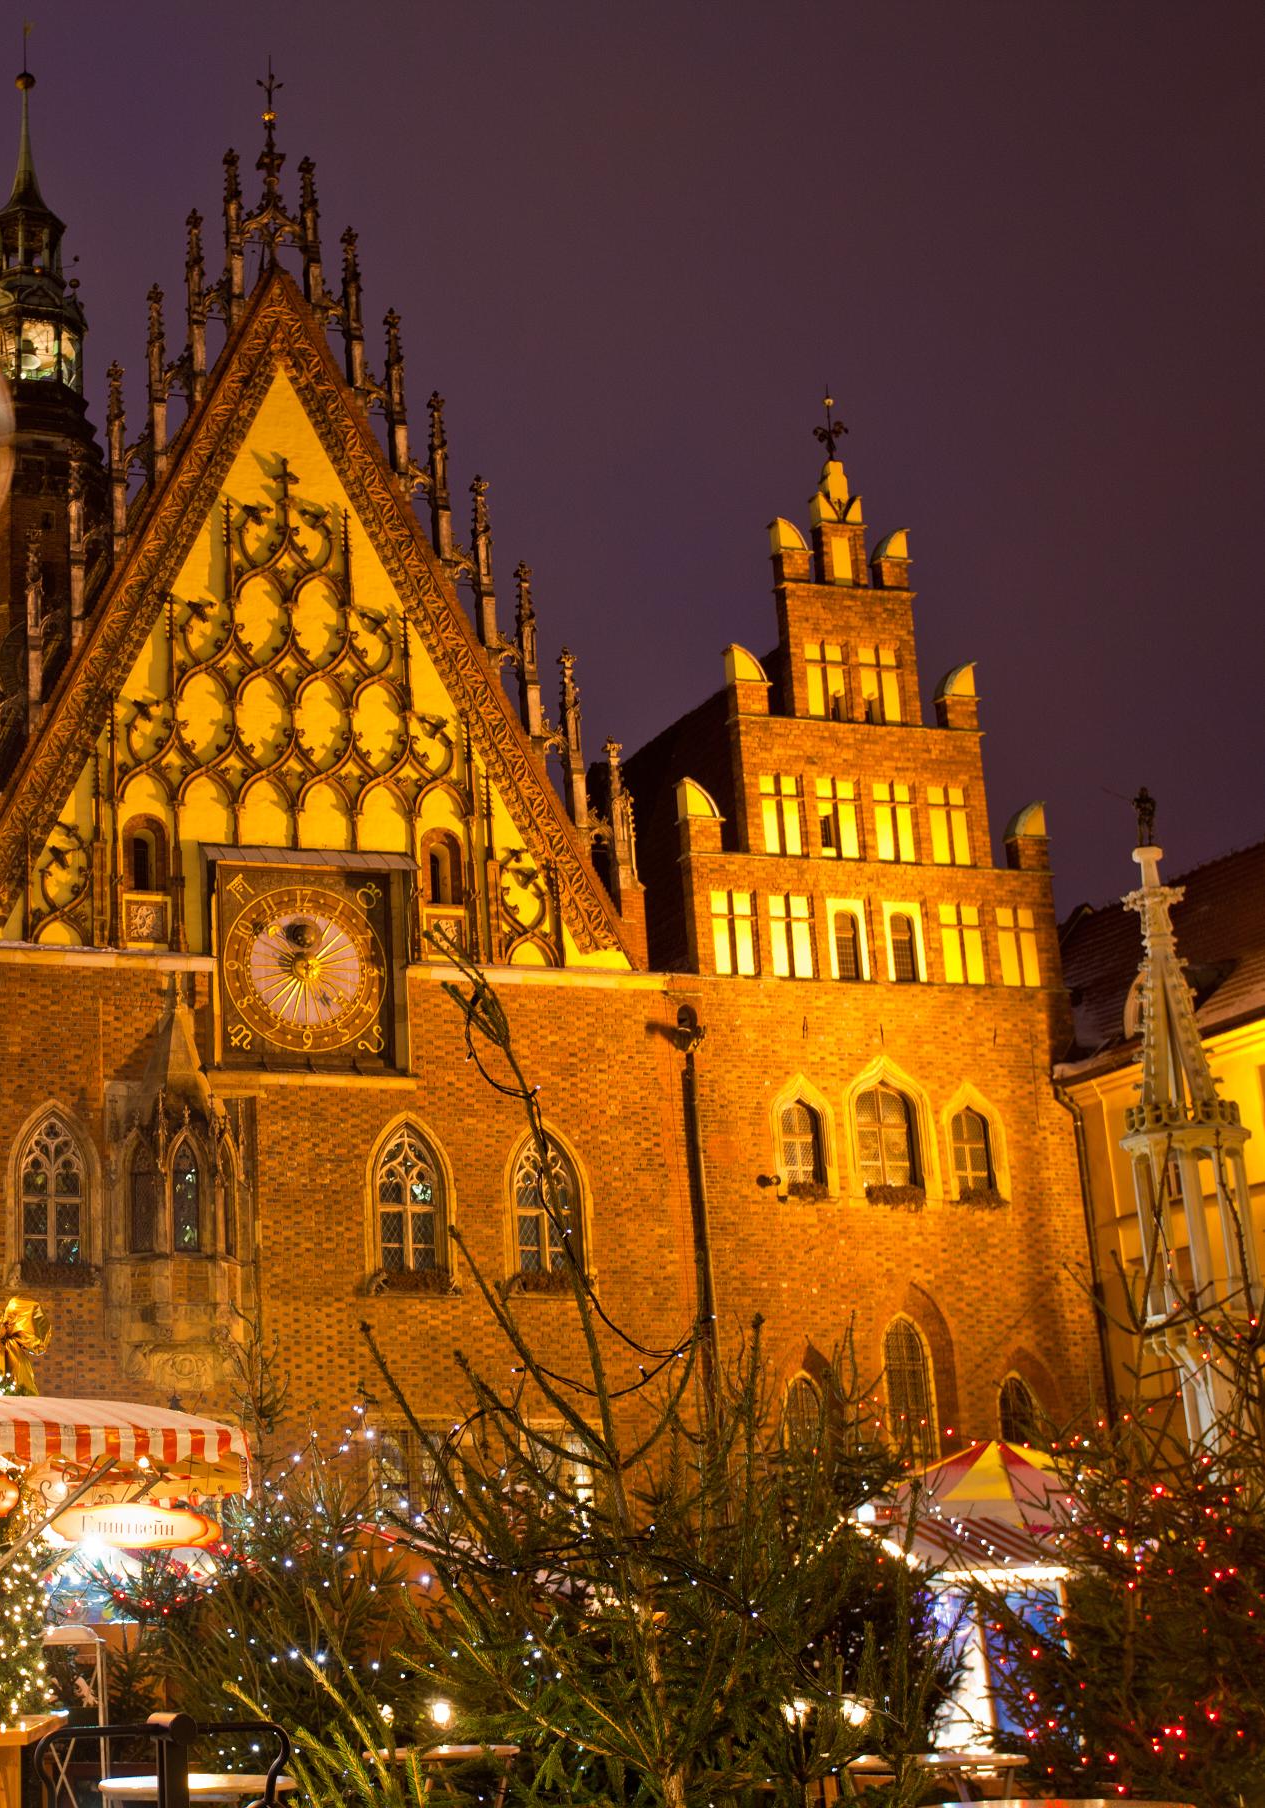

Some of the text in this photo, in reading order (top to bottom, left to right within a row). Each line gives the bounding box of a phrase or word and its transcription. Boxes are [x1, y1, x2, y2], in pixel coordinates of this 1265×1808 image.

[295, 889, 313, 907] 12
[235, 920, 254, 940] 10
[237, 995, 254, 1008] 8
